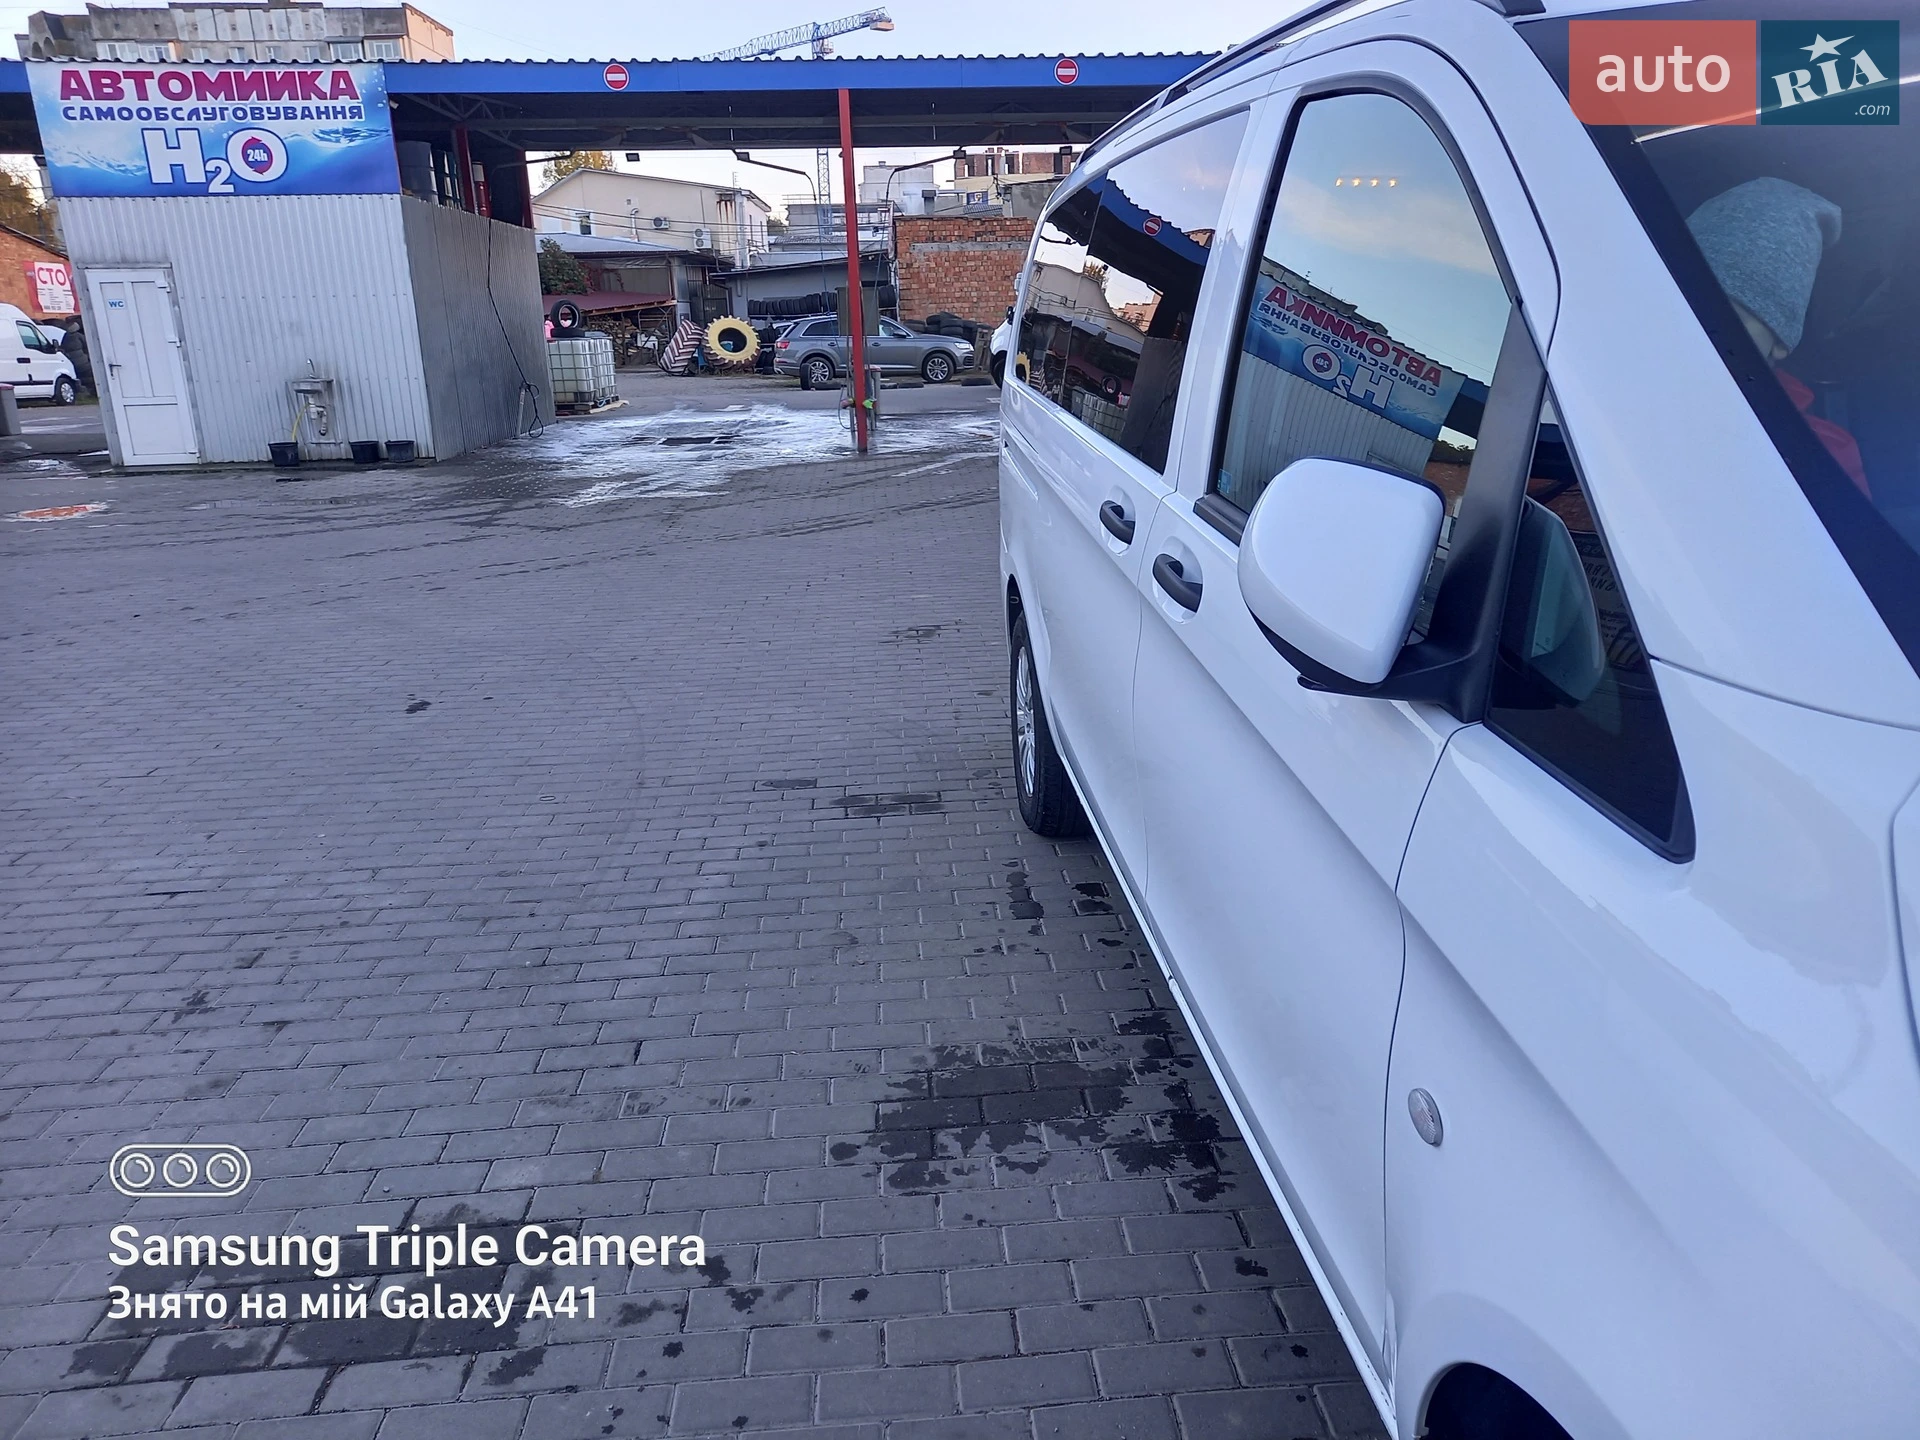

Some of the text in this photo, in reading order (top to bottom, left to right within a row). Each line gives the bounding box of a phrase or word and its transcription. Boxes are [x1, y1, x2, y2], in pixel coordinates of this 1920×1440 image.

[62, 105, 364, 122] САМООБСЛУГОВУВАННЯ
[246, 148, 269, 163] 24h
[37, 267, 67, 287] СТО
[108, 300, 125, 308] WC
